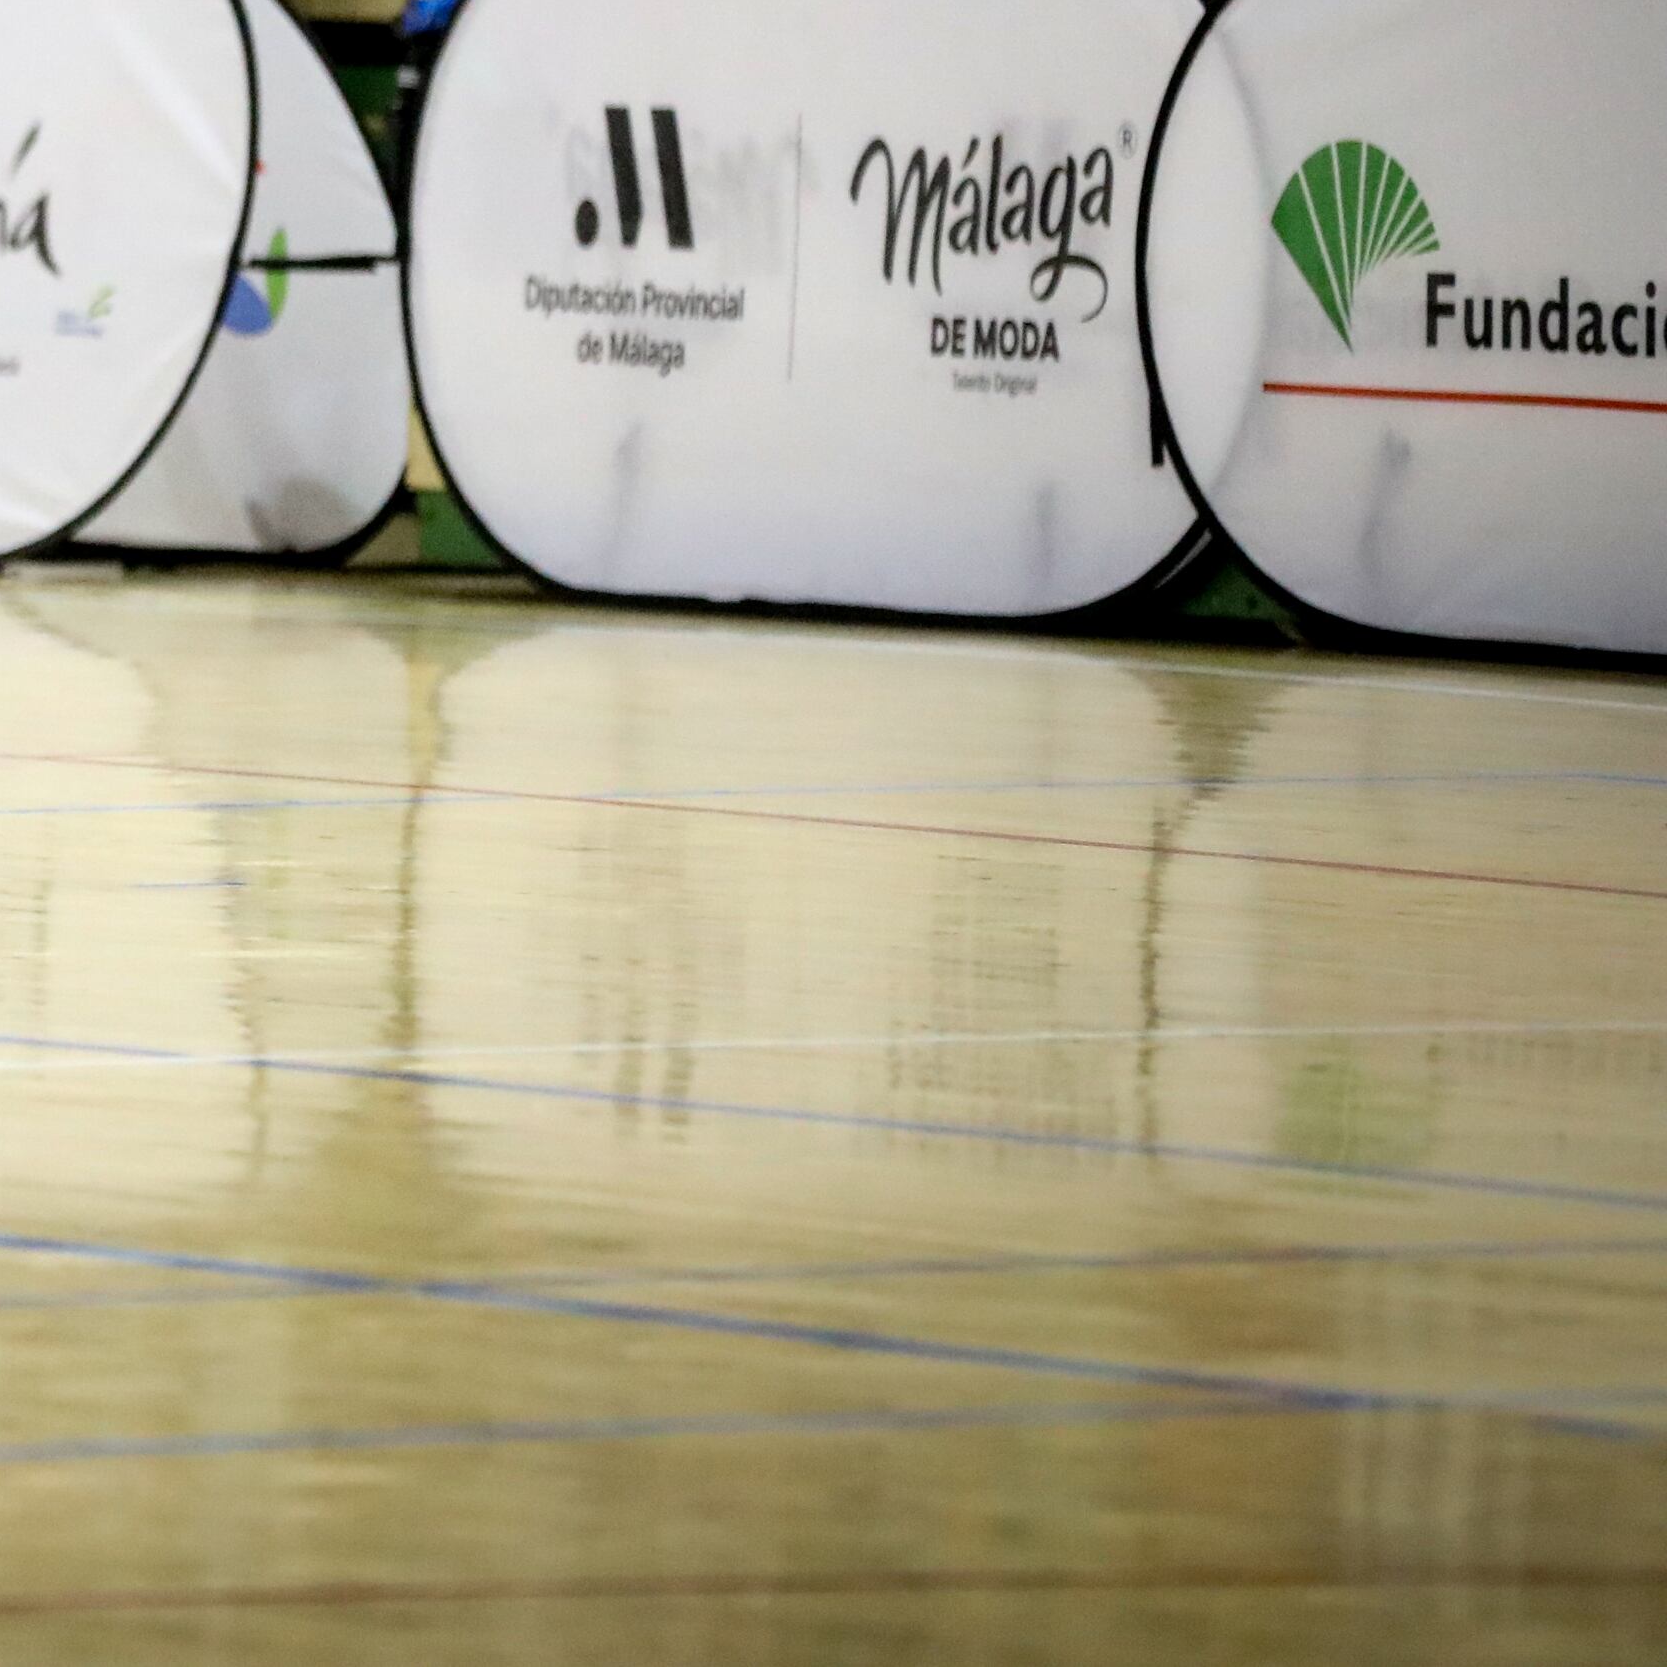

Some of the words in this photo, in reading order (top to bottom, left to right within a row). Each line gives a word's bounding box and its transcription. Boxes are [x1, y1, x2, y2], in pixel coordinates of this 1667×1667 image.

[849, 132, 1113, 324] Málaga
[641, 281, 746, 321] Provincial
[1425, 272, 1667, 357] Fundaci
[576, 332, 604, 365] de
[609, 332, 685, 378] Málaga
[930, 316, 967, 356] DE
[973, 318, 1060, 362] MODA
